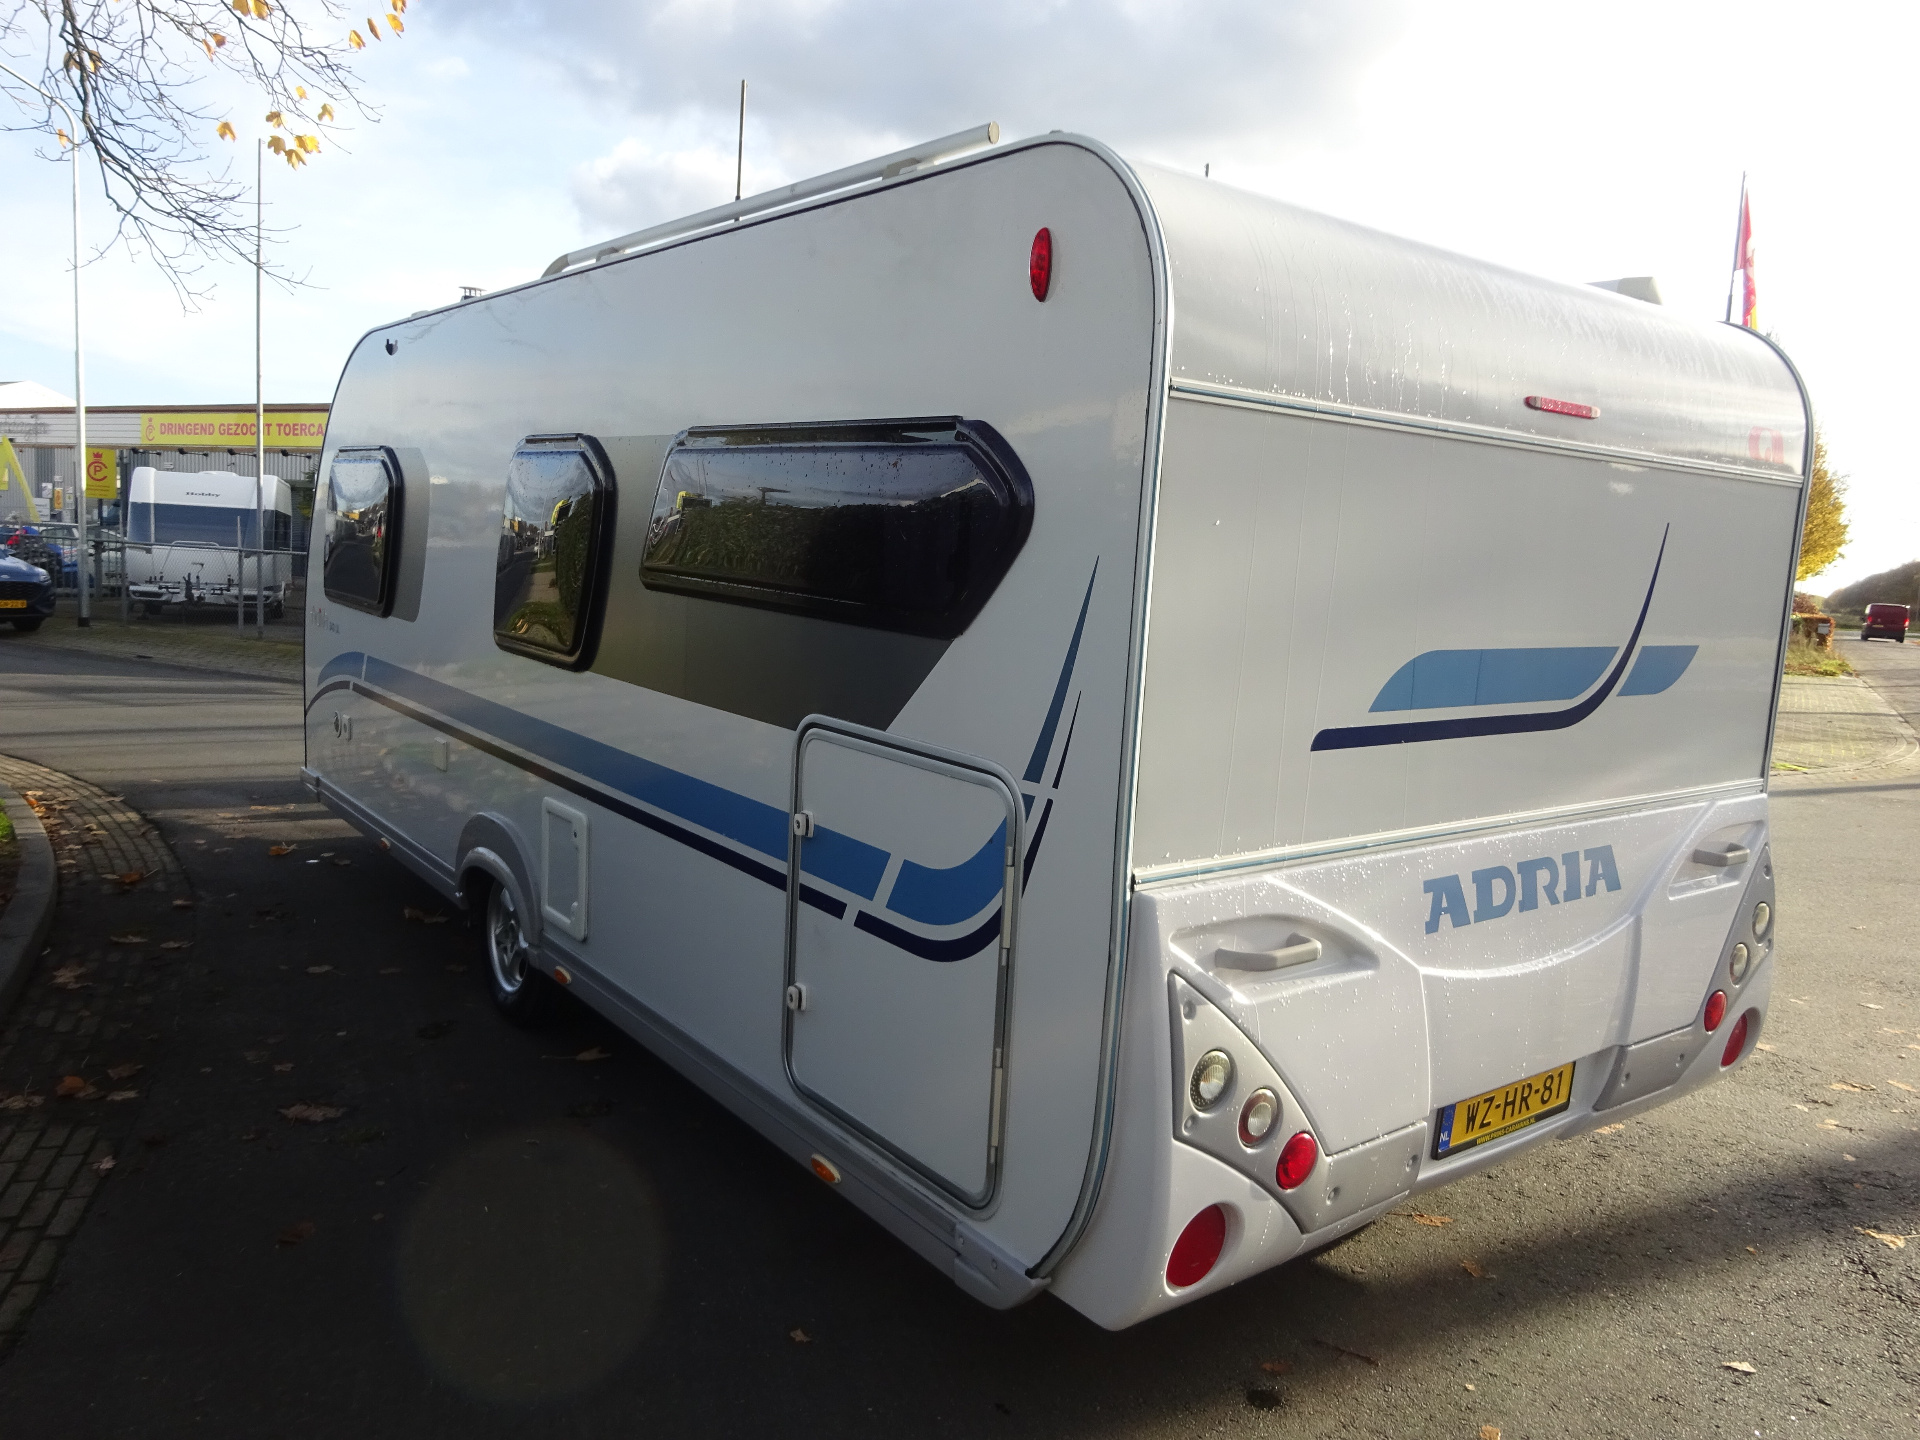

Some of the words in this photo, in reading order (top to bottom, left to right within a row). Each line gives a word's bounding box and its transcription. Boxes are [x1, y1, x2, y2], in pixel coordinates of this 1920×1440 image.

[160, 422, 215, 436] DRINGEND
[218, 423, 273, 437] GEZOCT
[1423, 845, 1622, 935] ADRIA
[1465, 1069, 1564, 1134] WZ-HR-81
[1440, 1131, 1450, 1143] NL
